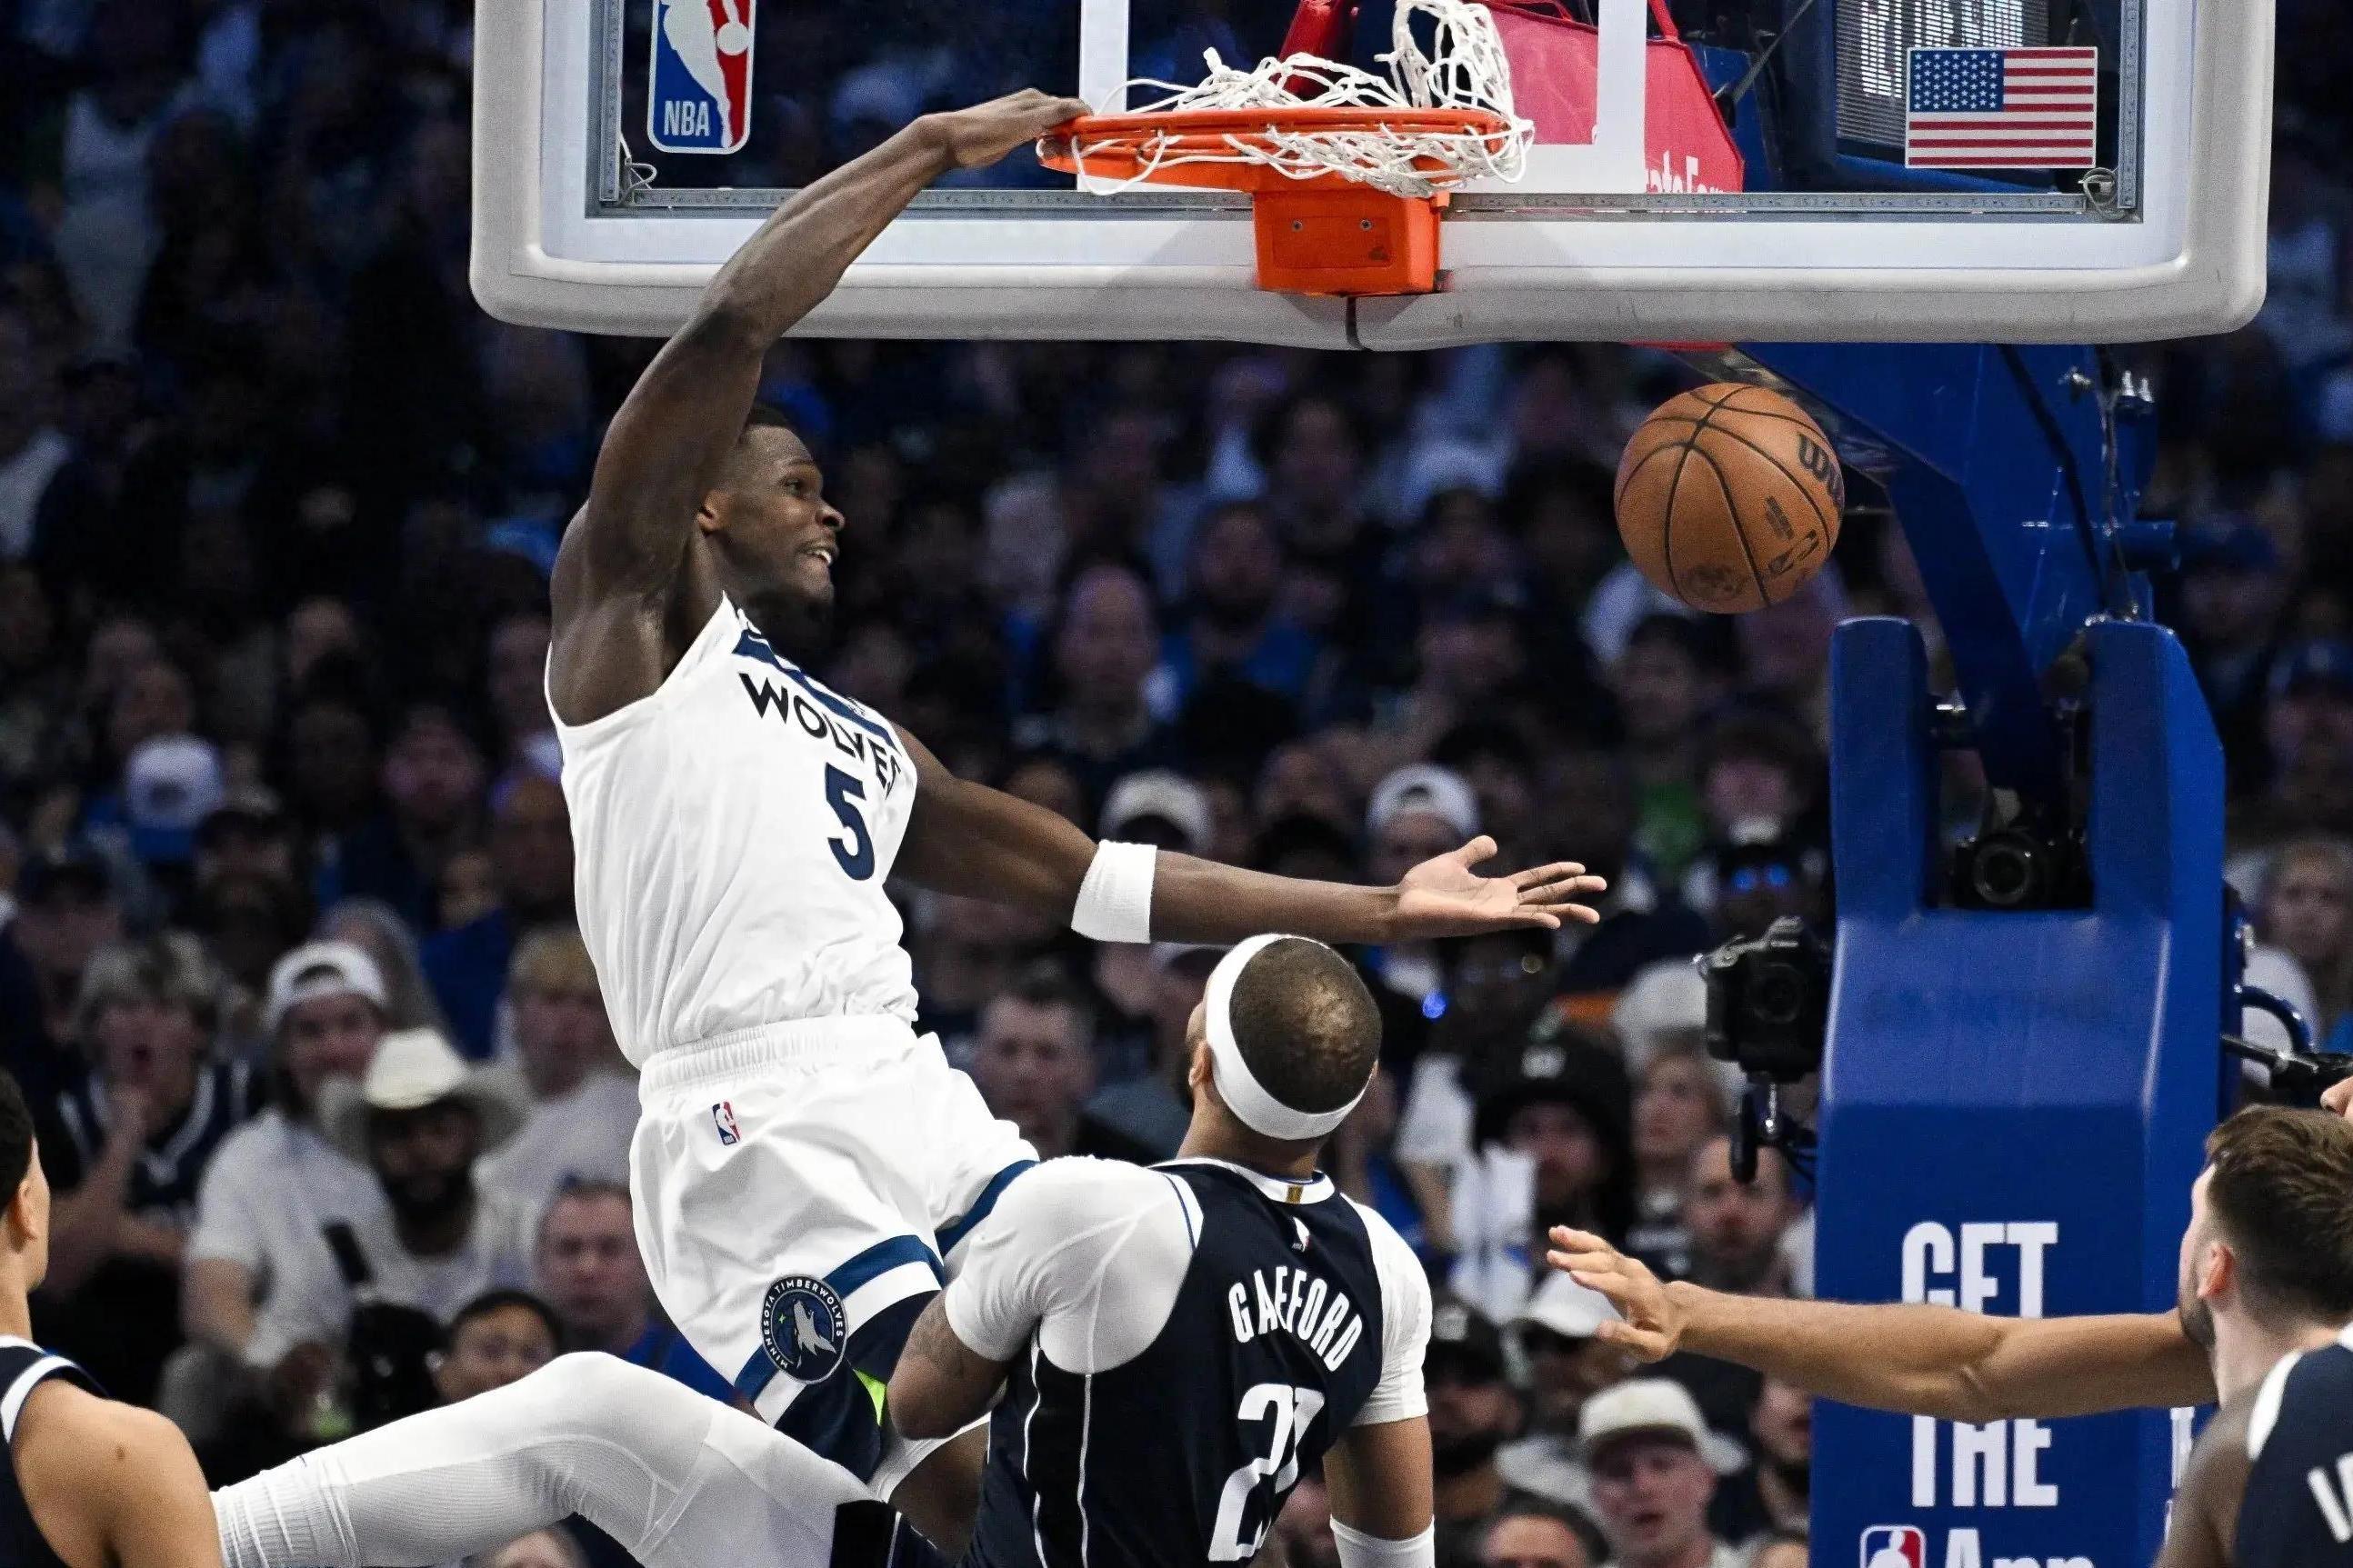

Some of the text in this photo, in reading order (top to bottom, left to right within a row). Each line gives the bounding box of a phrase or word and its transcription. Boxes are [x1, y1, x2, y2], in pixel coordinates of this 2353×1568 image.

[663, 100, 710, 137] NBA
[825, 762, 875, 882] 5
[762, 1278, 845, 1370] MINNESOTA TIMBERWOLVES
[1227, 1264, 1364, 1373] GAFFORD
